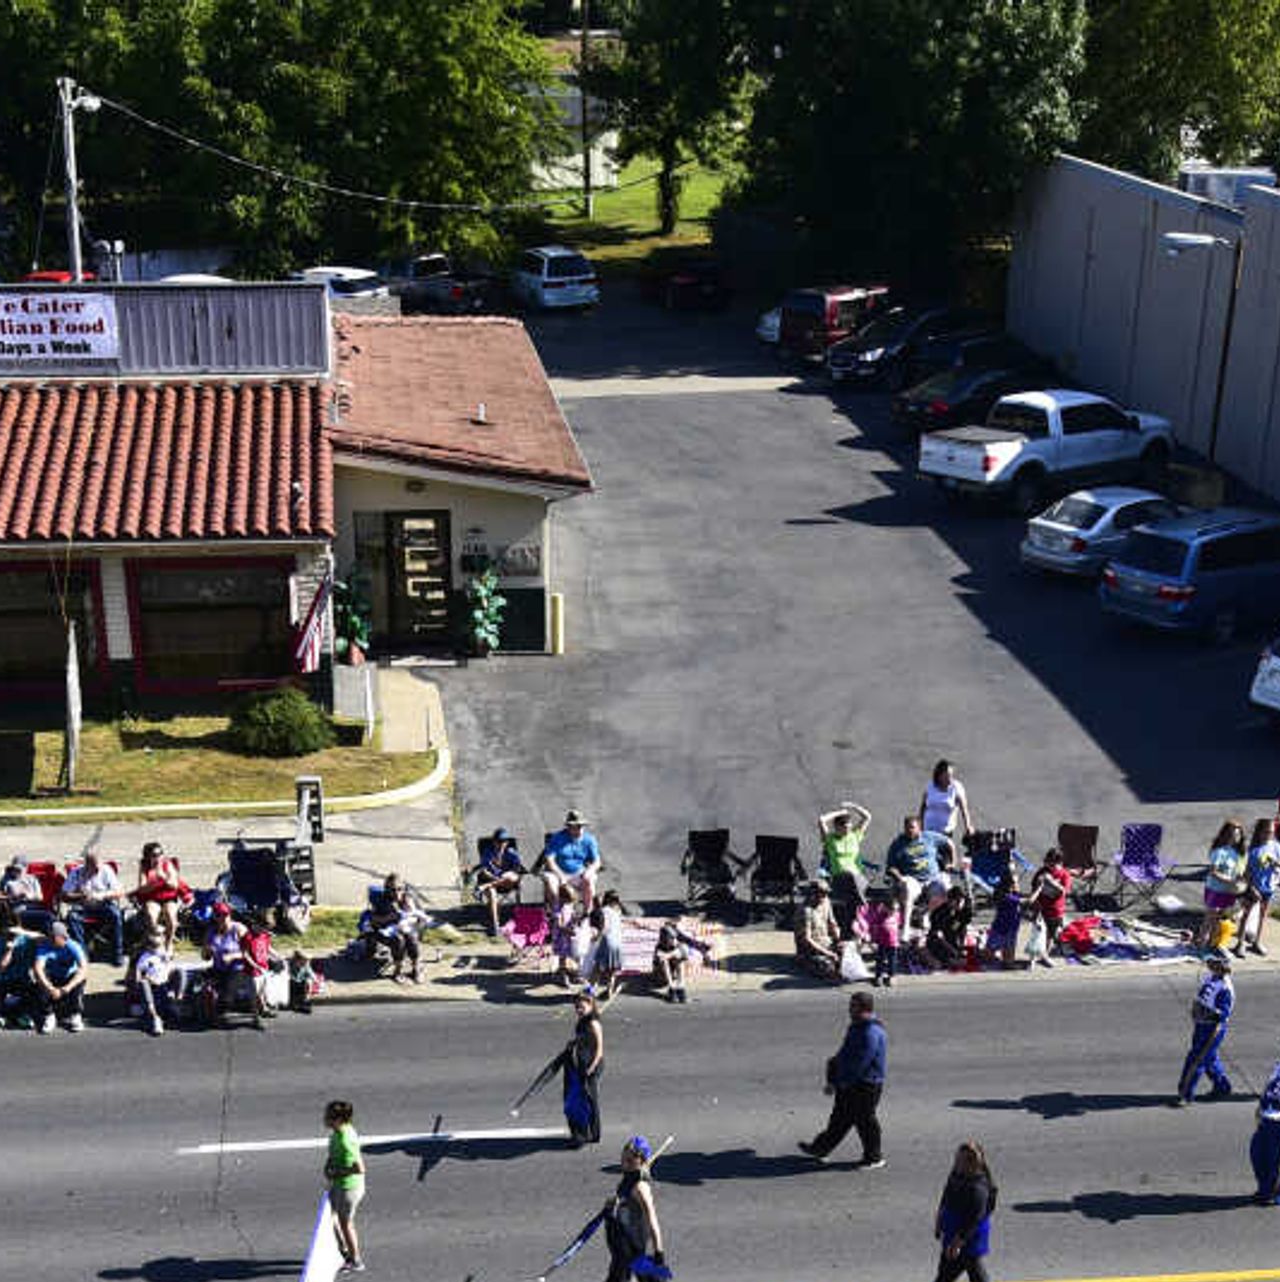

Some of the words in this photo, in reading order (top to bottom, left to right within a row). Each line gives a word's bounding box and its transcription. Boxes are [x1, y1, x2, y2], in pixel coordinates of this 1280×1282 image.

[21, 298, 84, 313] Cater
[50, 318, 104, 334] Food
[38, 343, 46, 354] a
[51, 340, 91, 355] Week
